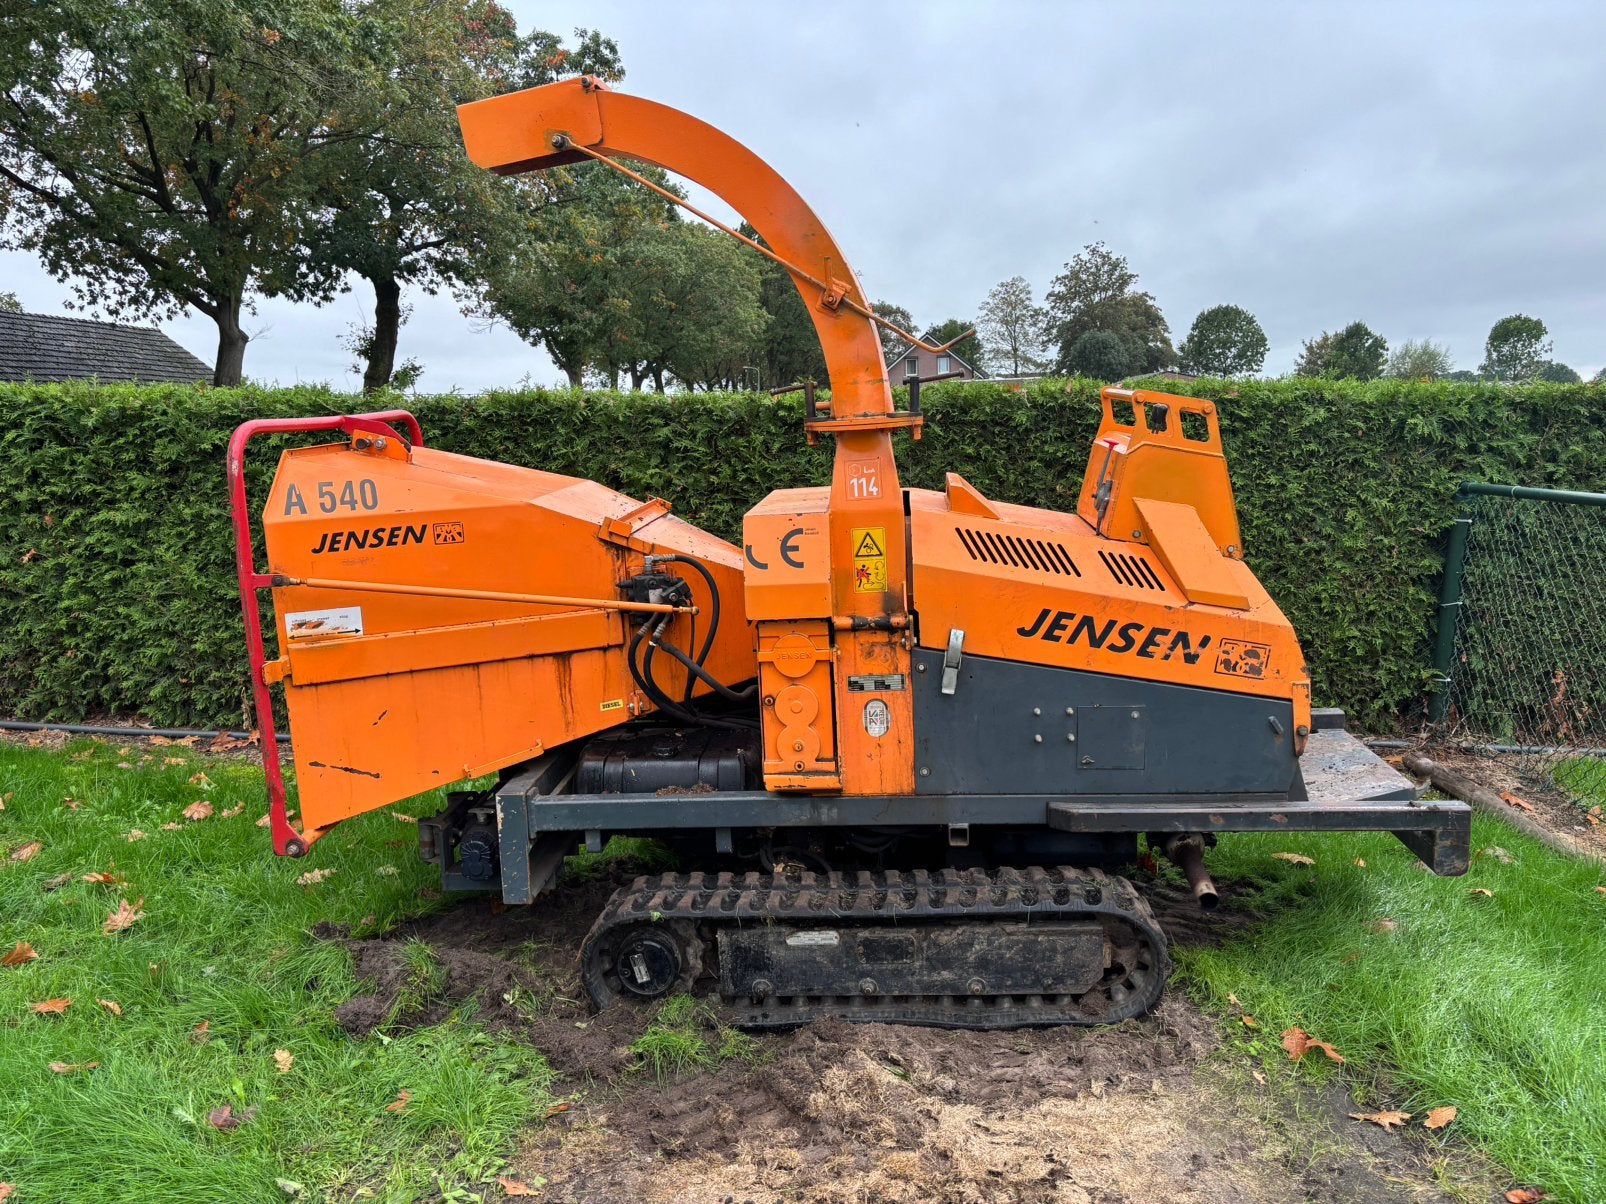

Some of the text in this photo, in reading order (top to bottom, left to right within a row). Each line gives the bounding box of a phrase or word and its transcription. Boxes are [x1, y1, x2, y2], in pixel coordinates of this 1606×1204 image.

[283, 478, 379, 516] A 540
[849, 476, 879, 497] 114
[311, 523, 428, 555] JENSEN
[1016, 608, 1212, 665] JENSEN
[601, 701, 621, 710] DIESEL
